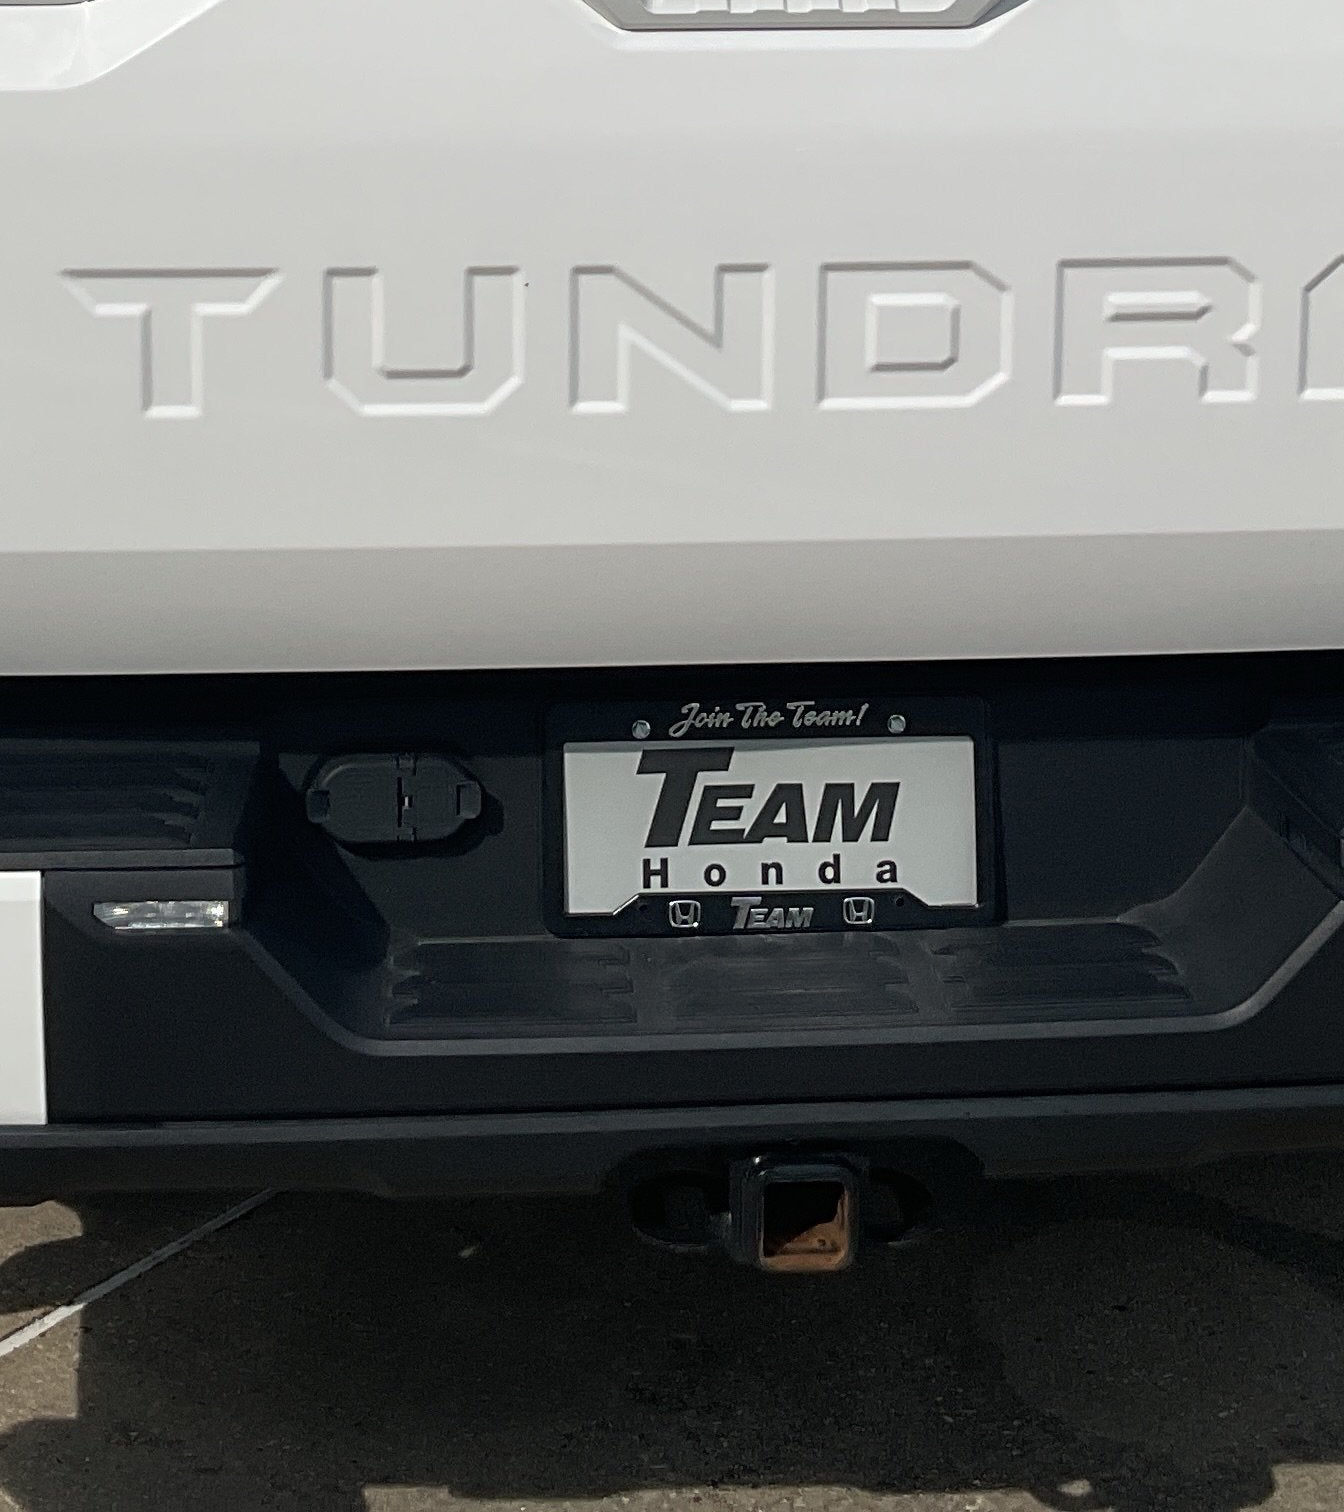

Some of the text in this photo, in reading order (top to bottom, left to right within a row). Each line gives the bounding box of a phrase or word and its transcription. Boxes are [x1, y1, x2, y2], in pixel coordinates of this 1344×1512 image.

[668, 700, 870, 737] Join The Team!
[636, 746, 900, 848] TEAM
[642, 853, 899, 889] Honda
[729, 896, 815, 930] TEAM
